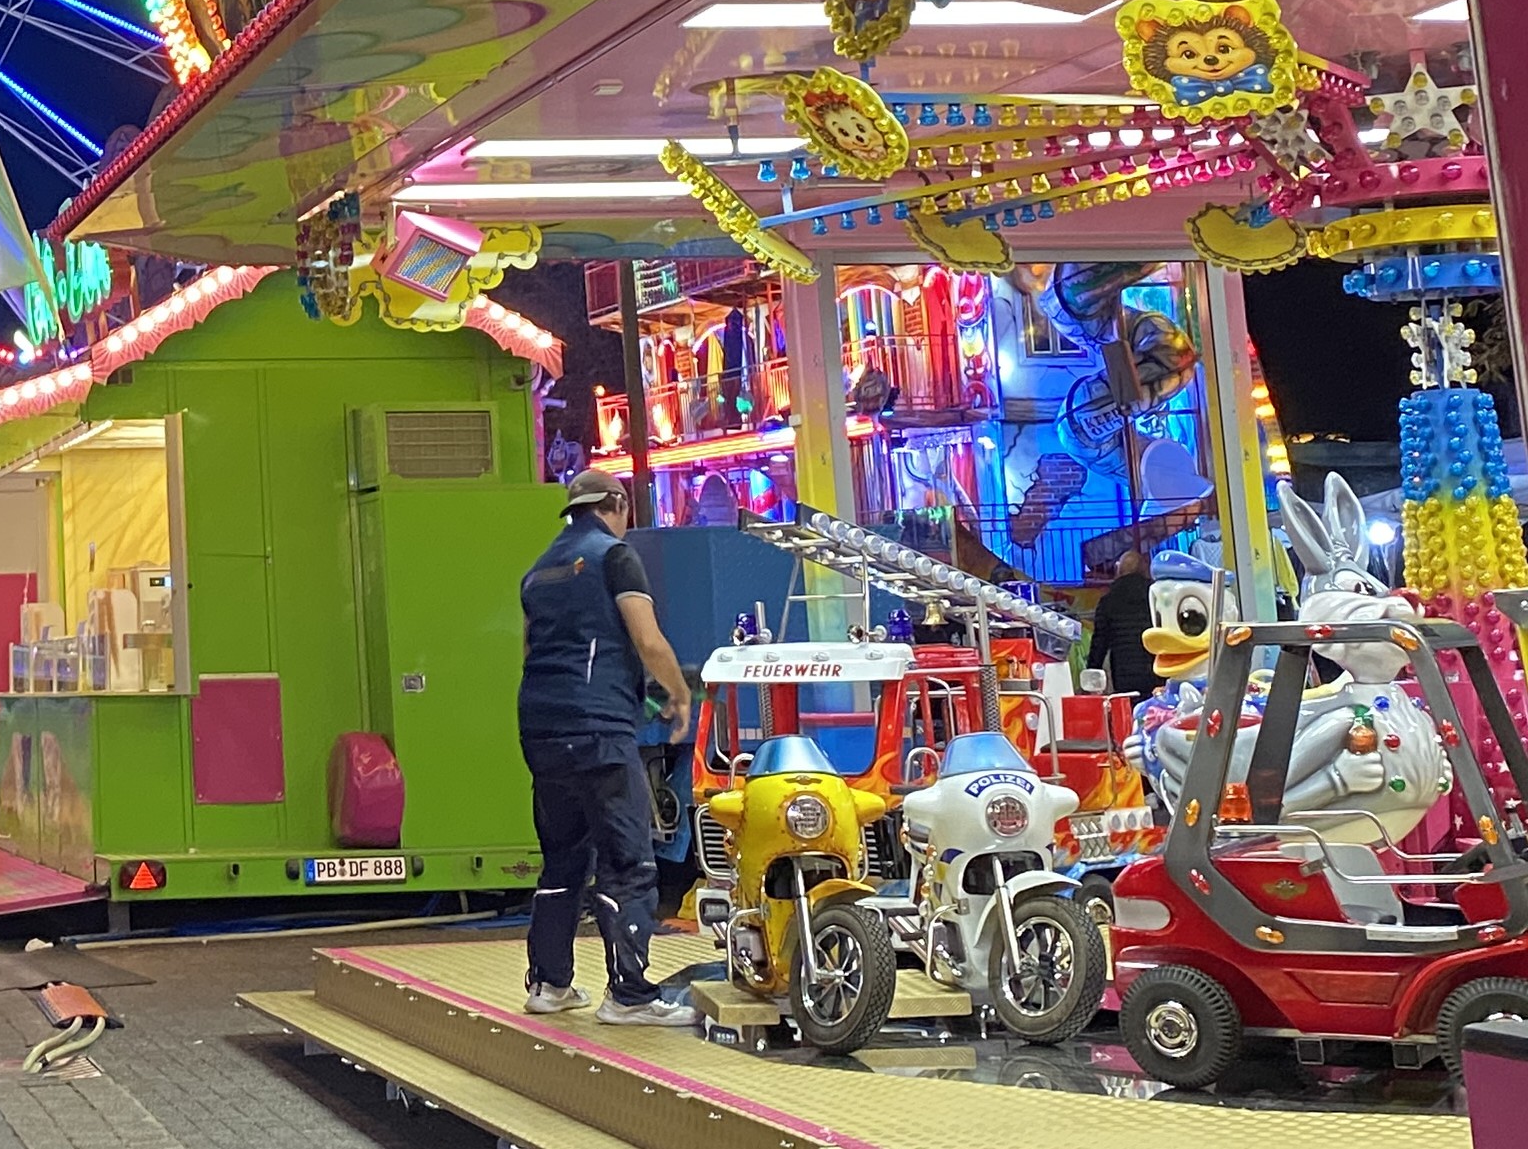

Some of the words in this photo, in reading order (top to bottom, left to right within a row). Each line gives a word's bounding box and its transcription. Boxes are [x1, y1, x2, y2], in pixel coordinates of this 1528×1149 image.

[743, 664, 842, 678] FEUERWEHR
[968, 774, 1032, 795] POLIZEI
[317, 861, 337, 878] PB
[349, 860, 369, 877] DF
[374, 859, 403, 876] 888
